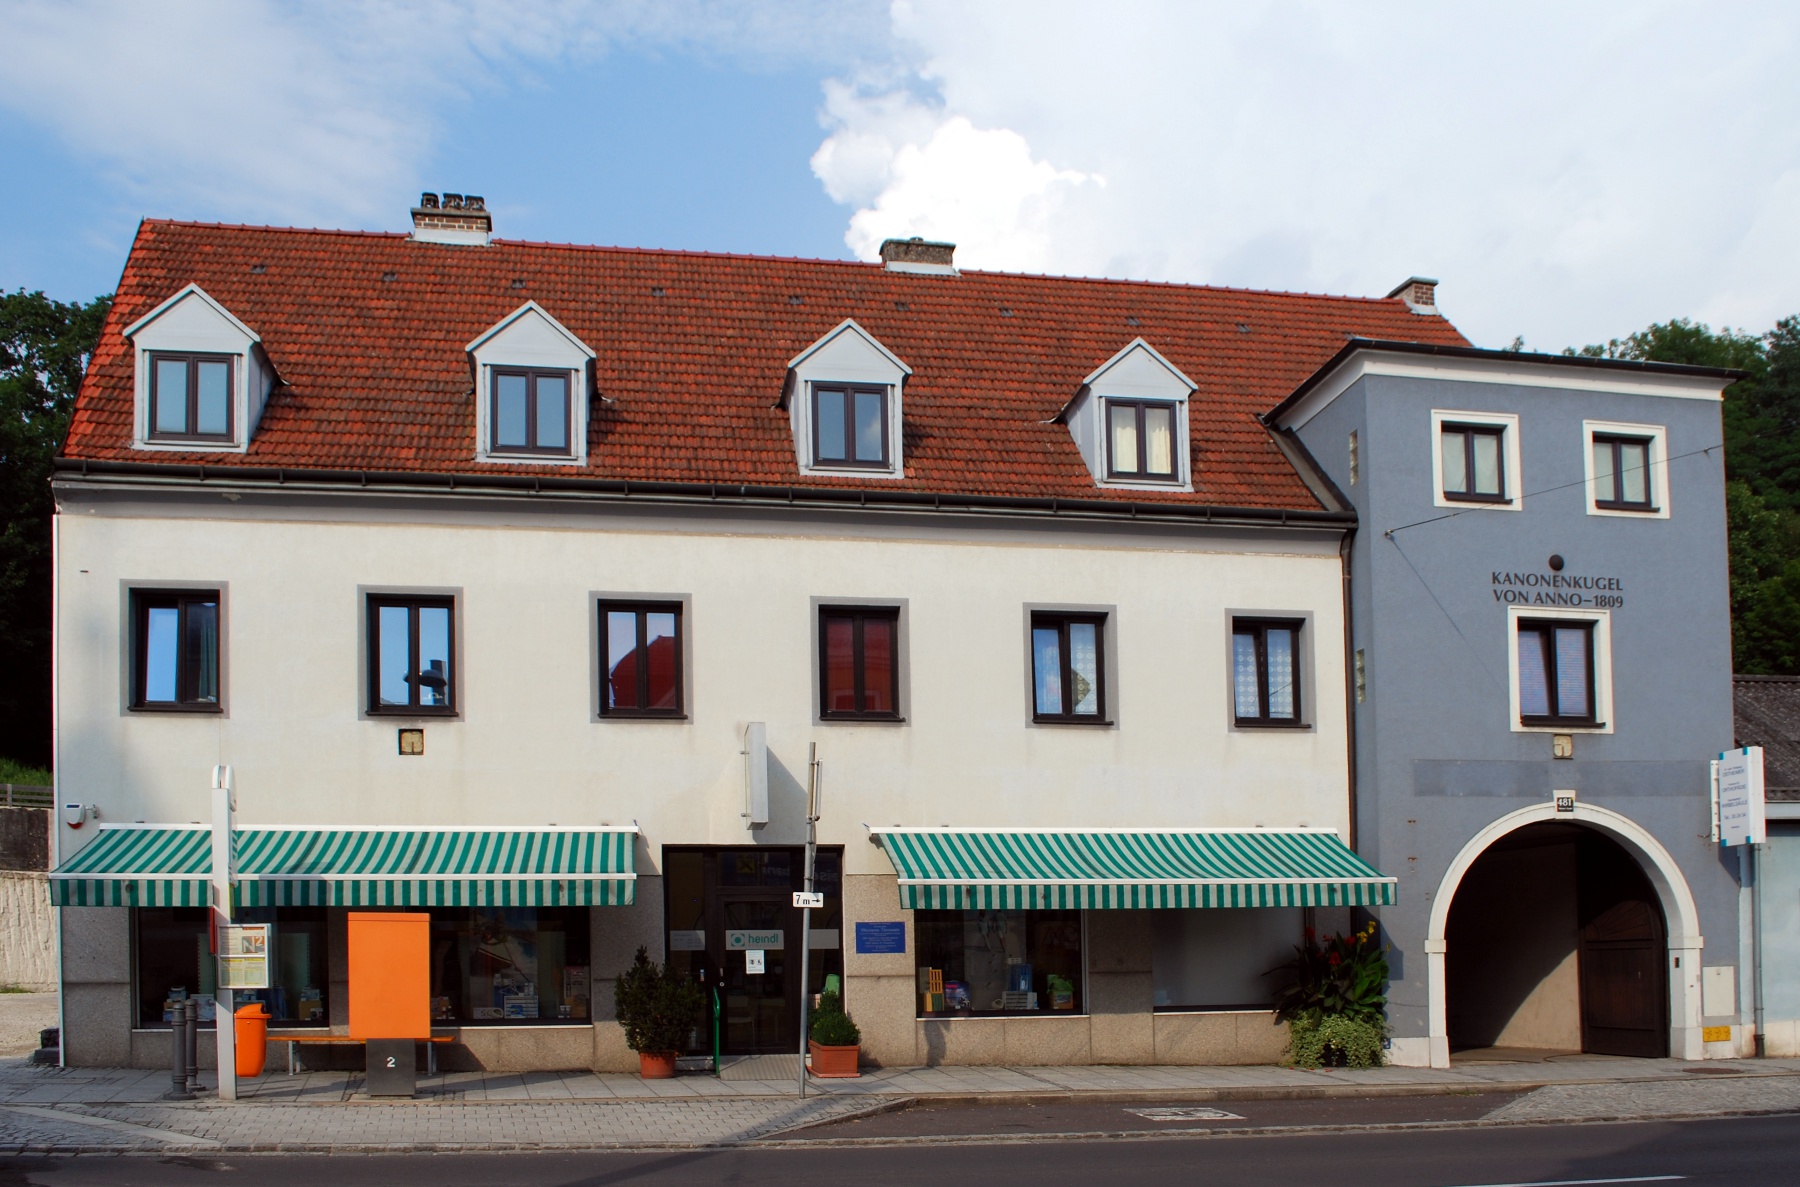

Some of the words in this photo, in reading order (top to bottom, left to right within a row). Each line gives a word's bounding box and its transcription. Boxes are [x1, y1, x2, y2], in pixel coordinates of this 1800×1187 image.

[1492, 571, 1623, 591] KANONENKUGEL
[1493, 589, 1529, 604] VON
[1557, 797, 1572, 806] 481
[796, 895, 801, 905] 7
[748, 933, 779, 944] heindl
[386, 1056, 396, 1068] 2
